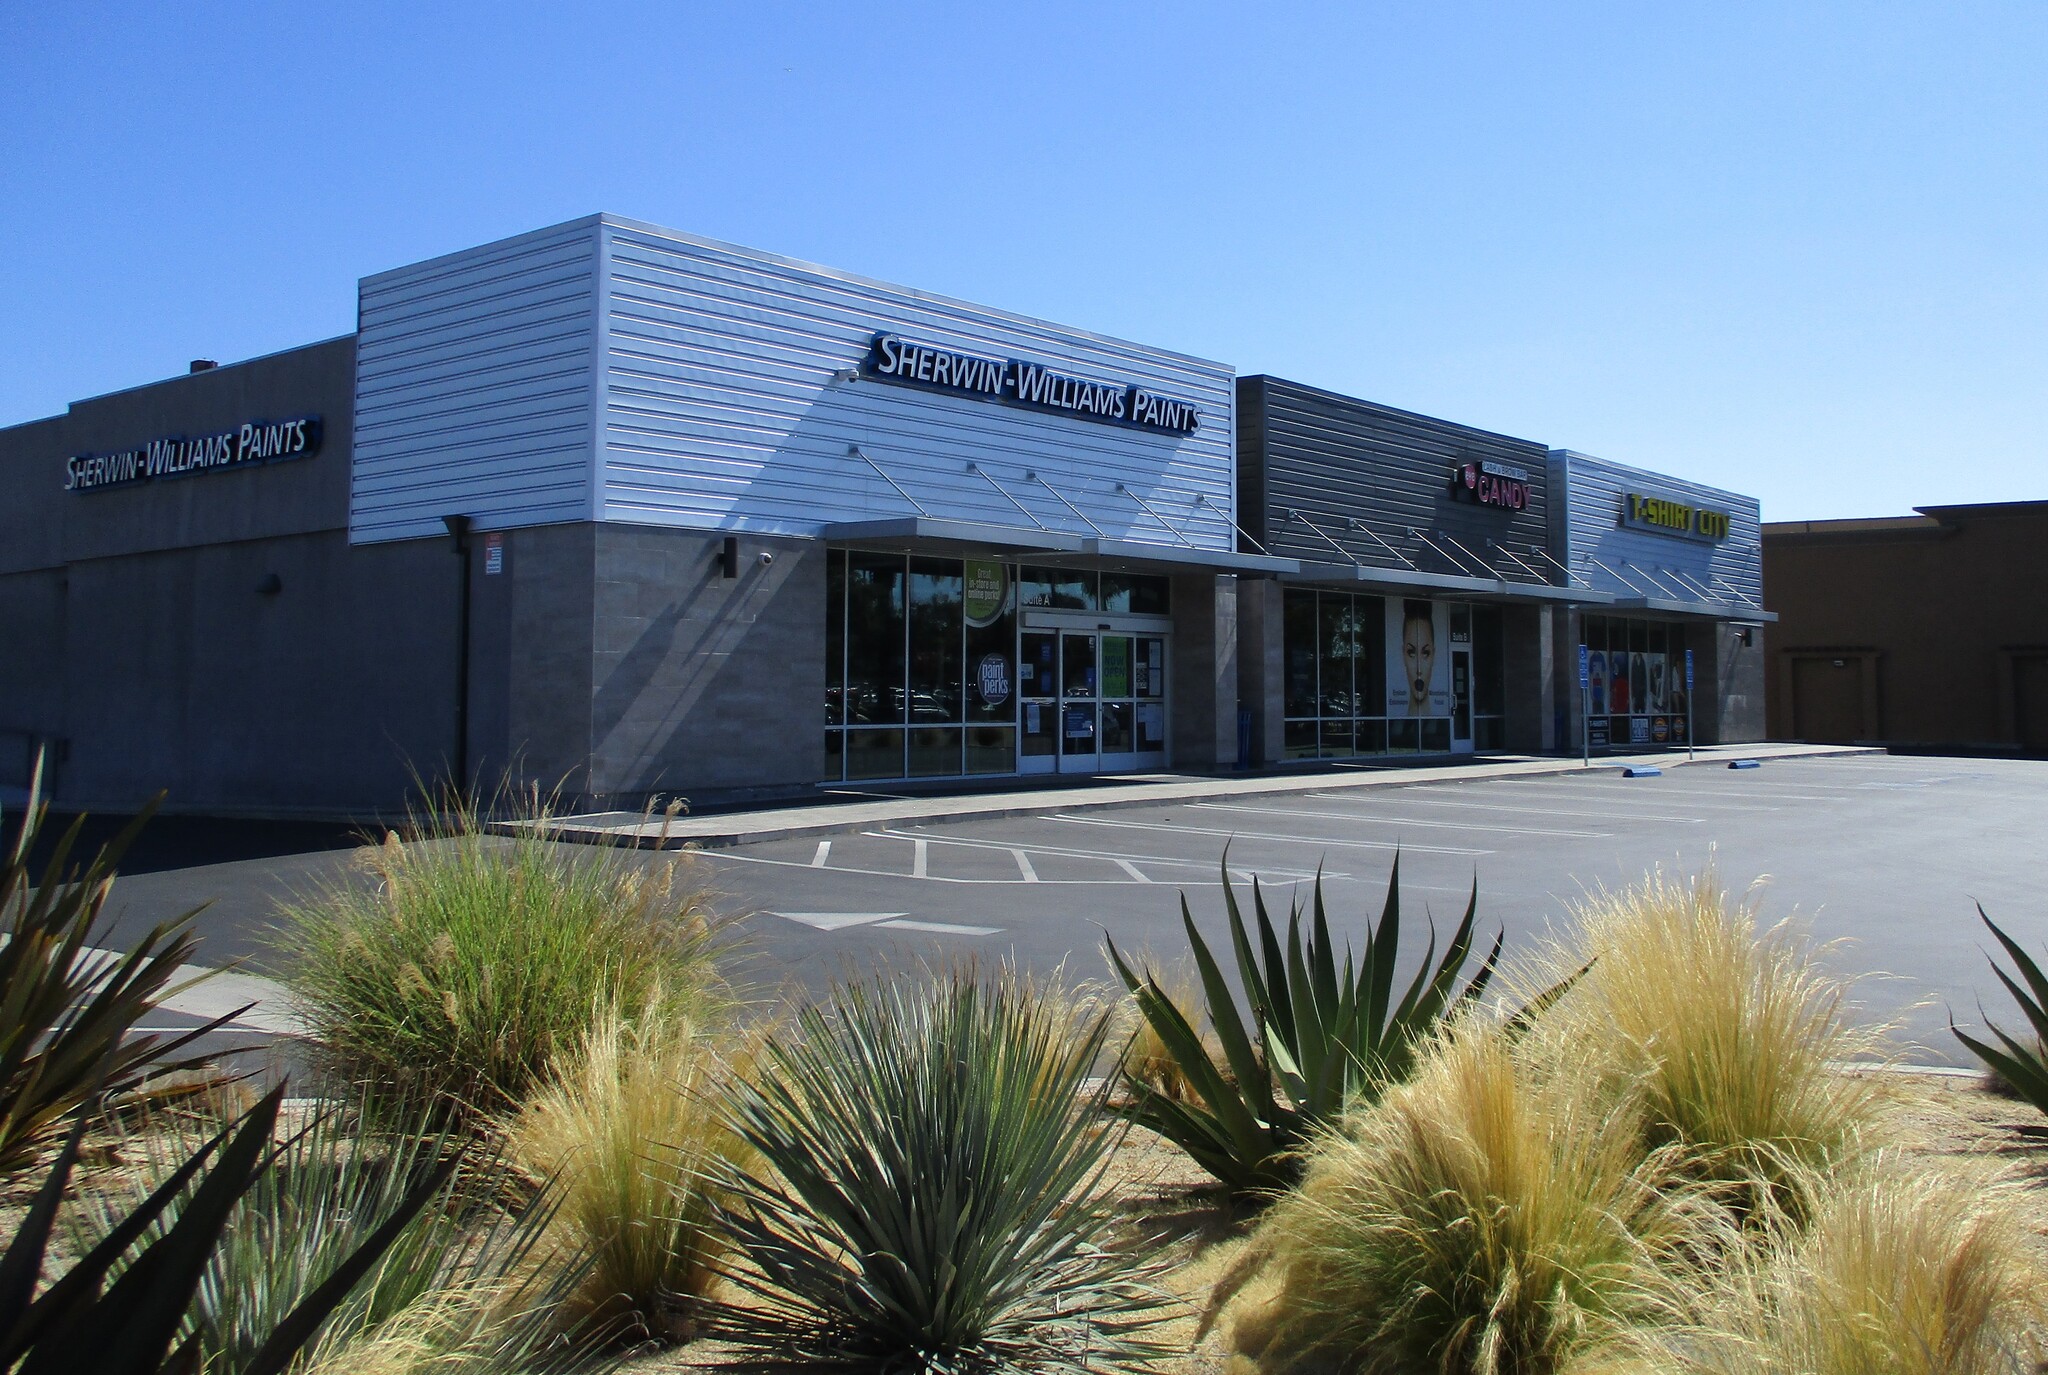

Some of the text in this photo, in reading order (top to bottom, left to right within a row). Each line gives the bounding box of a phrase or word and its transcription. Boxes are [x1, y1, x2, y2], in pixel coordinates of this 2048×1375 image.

[878, 334, 1202, 433] SHERWIN-WILLIAMS PAINTS
[64, 419, 307, 490] SHERWIN-WILLIAMS PAINTS
[1478, 475, 1532, 511] CANDY
[1631, 493, 1731, 539] T-SHIRT CITY
[1043, 594, 1051, 606] A
[1104, 655, 1124, 666] NOW
[982, 661, 1004, 681] paint
[1104, 666, 1126, 678] OPEN
[984, 678, 1008, 696] perks
